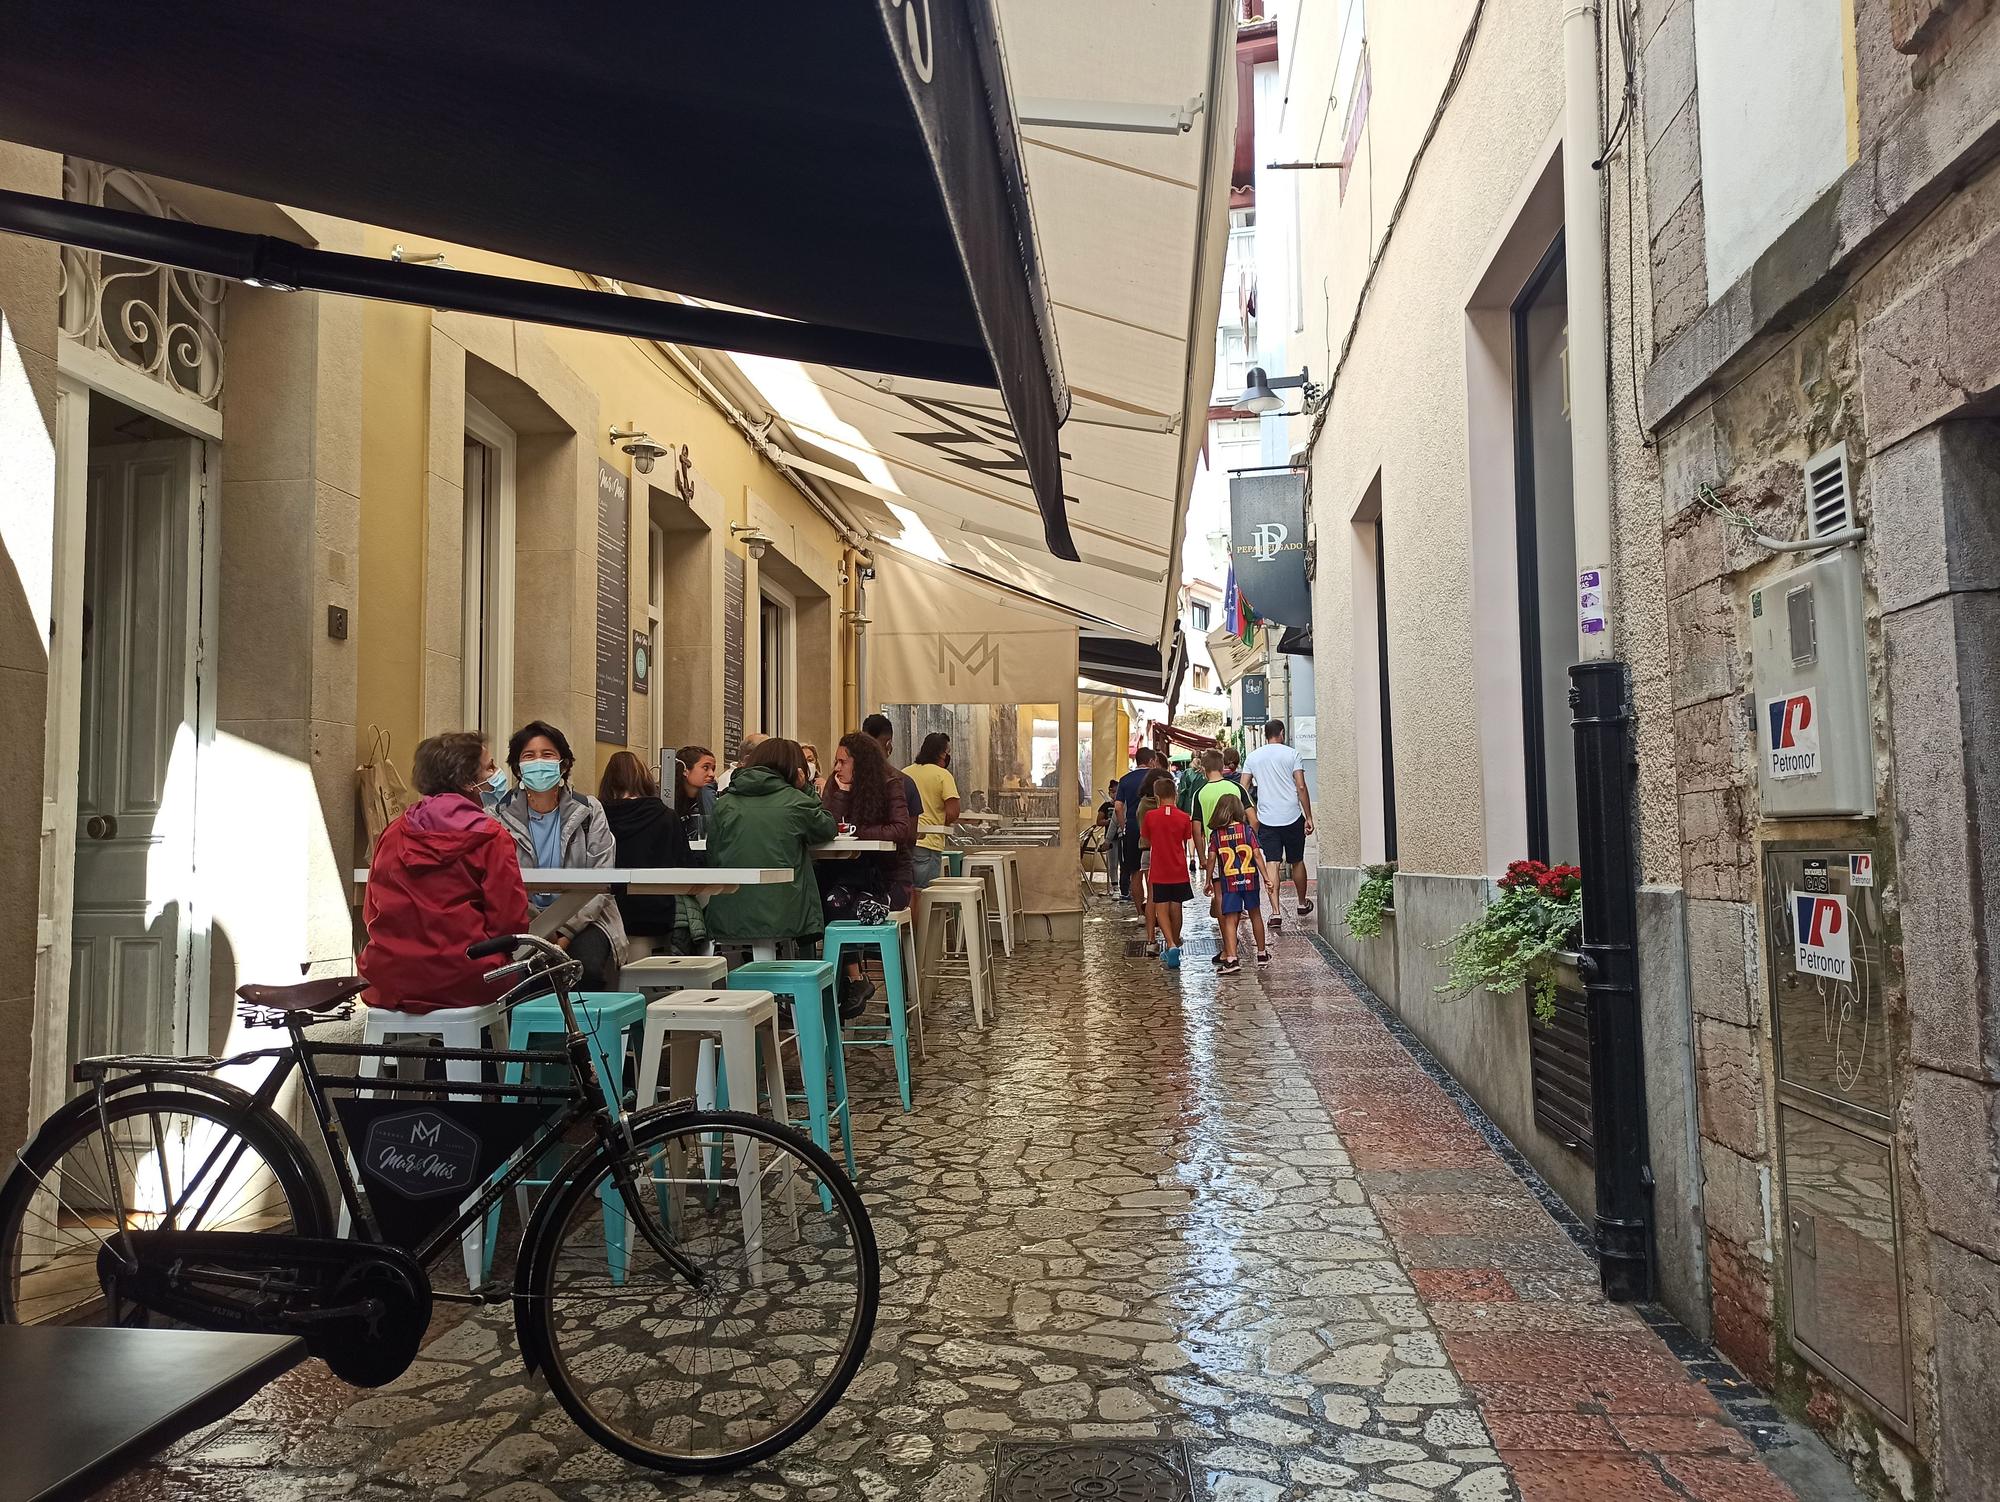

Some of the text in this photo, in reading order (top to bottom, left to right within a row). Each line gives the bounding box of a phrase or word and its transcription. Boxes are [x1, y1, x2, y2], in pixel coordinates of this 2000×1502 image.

[1772, 752, 1816, 773] Petronor
[1218, 844, 1256, 877] 22
[1805, 876, 1828, 892] GAS
[1852, 875, 1871, 884] Petronor
[1799, 947, 1846, 976] Petronor
[422, 1153, 457, 1180] Más
